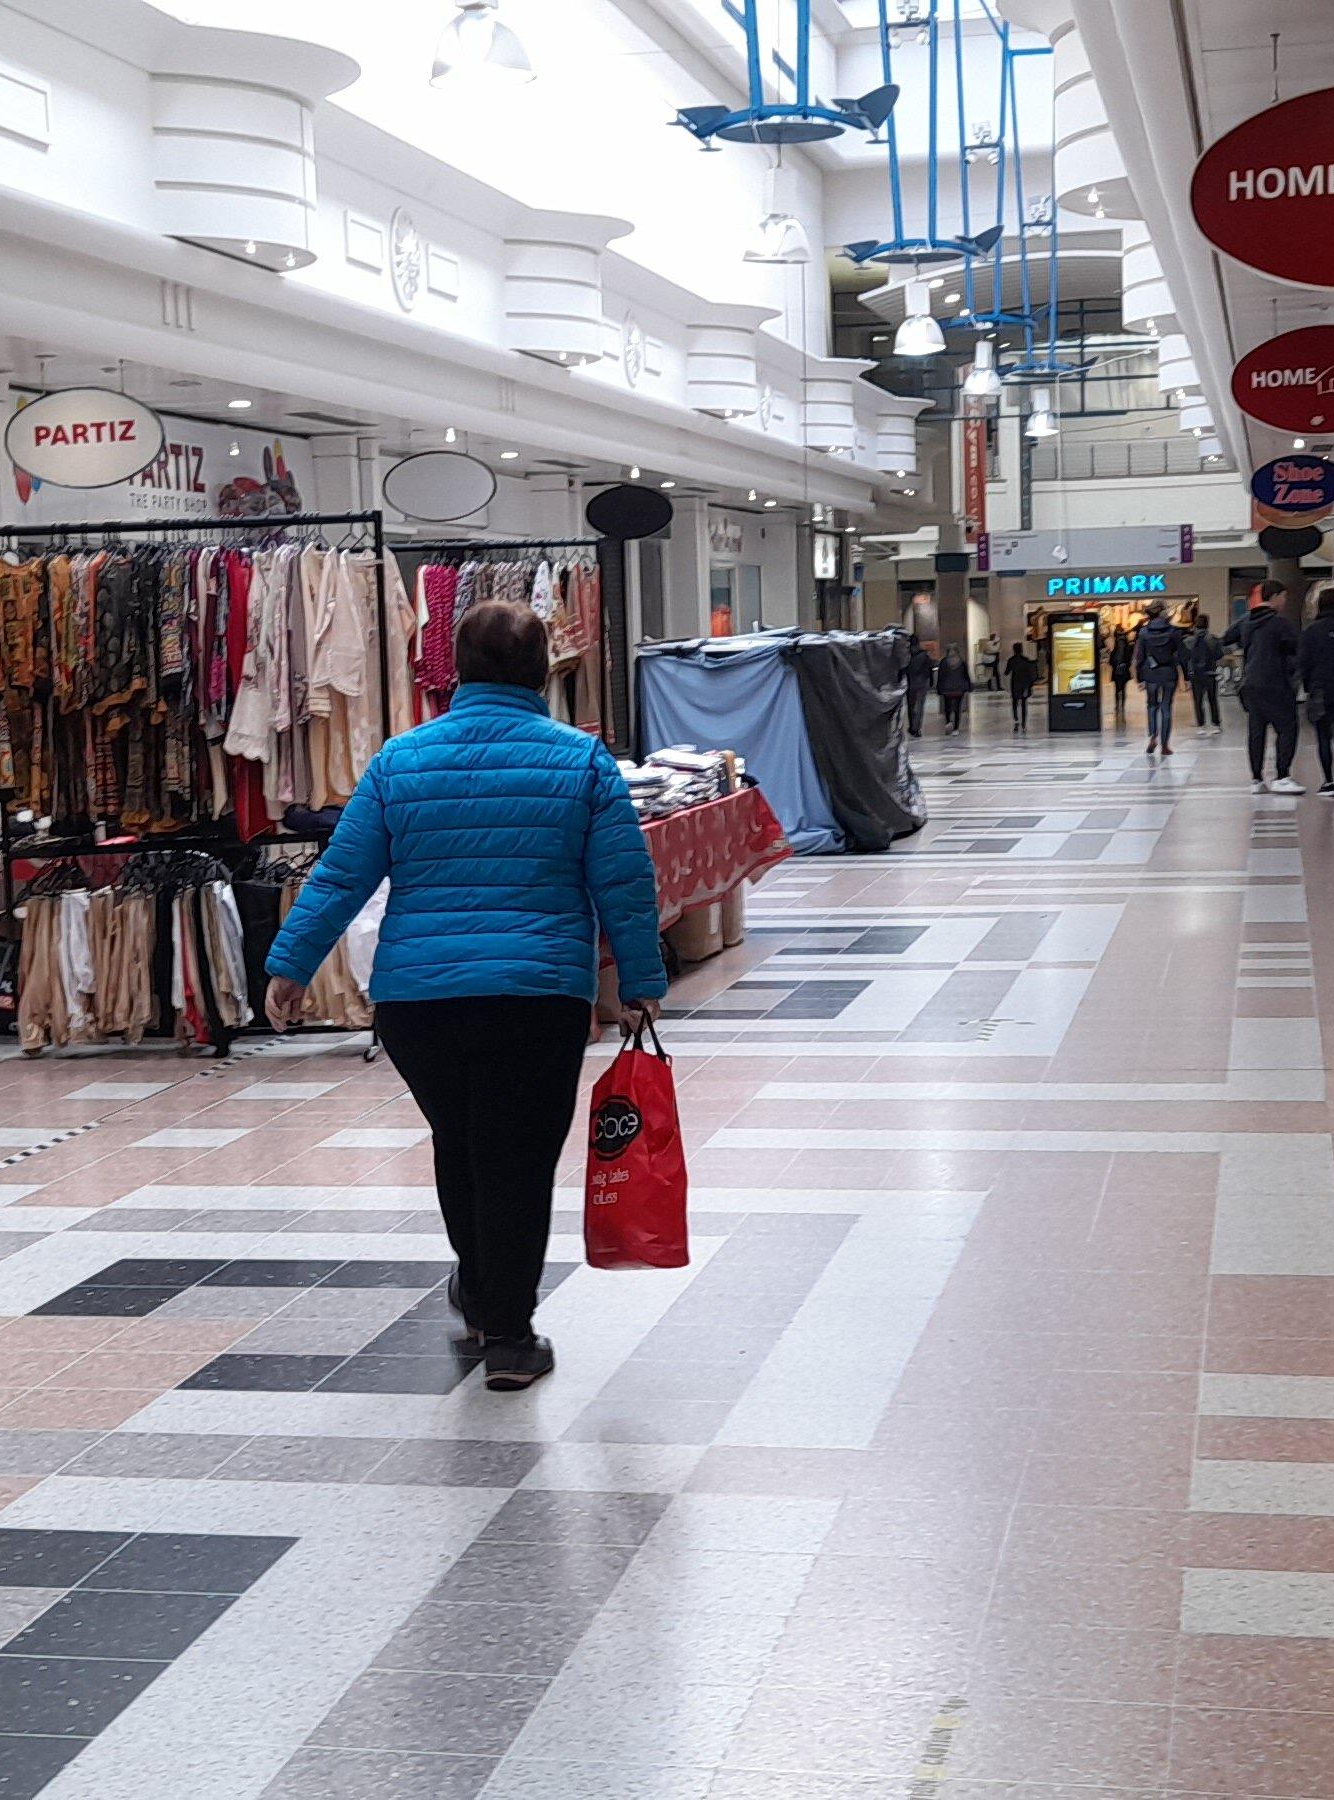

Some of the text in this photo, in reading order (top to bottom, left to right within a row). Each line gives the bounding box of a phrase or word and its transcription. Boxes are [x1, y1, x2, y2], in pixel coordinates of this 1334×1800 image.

[1250, 367, 1317, 389] HOME
[33, 419, 137, 447] PARTIZ
[129, 443, 206, 493] ARTIZ
[1272, 461, 1325, 482] Shoe
[1272, 483, 1325, 505] Zone
[1047, 573, 1166, 597] PRIMARK
